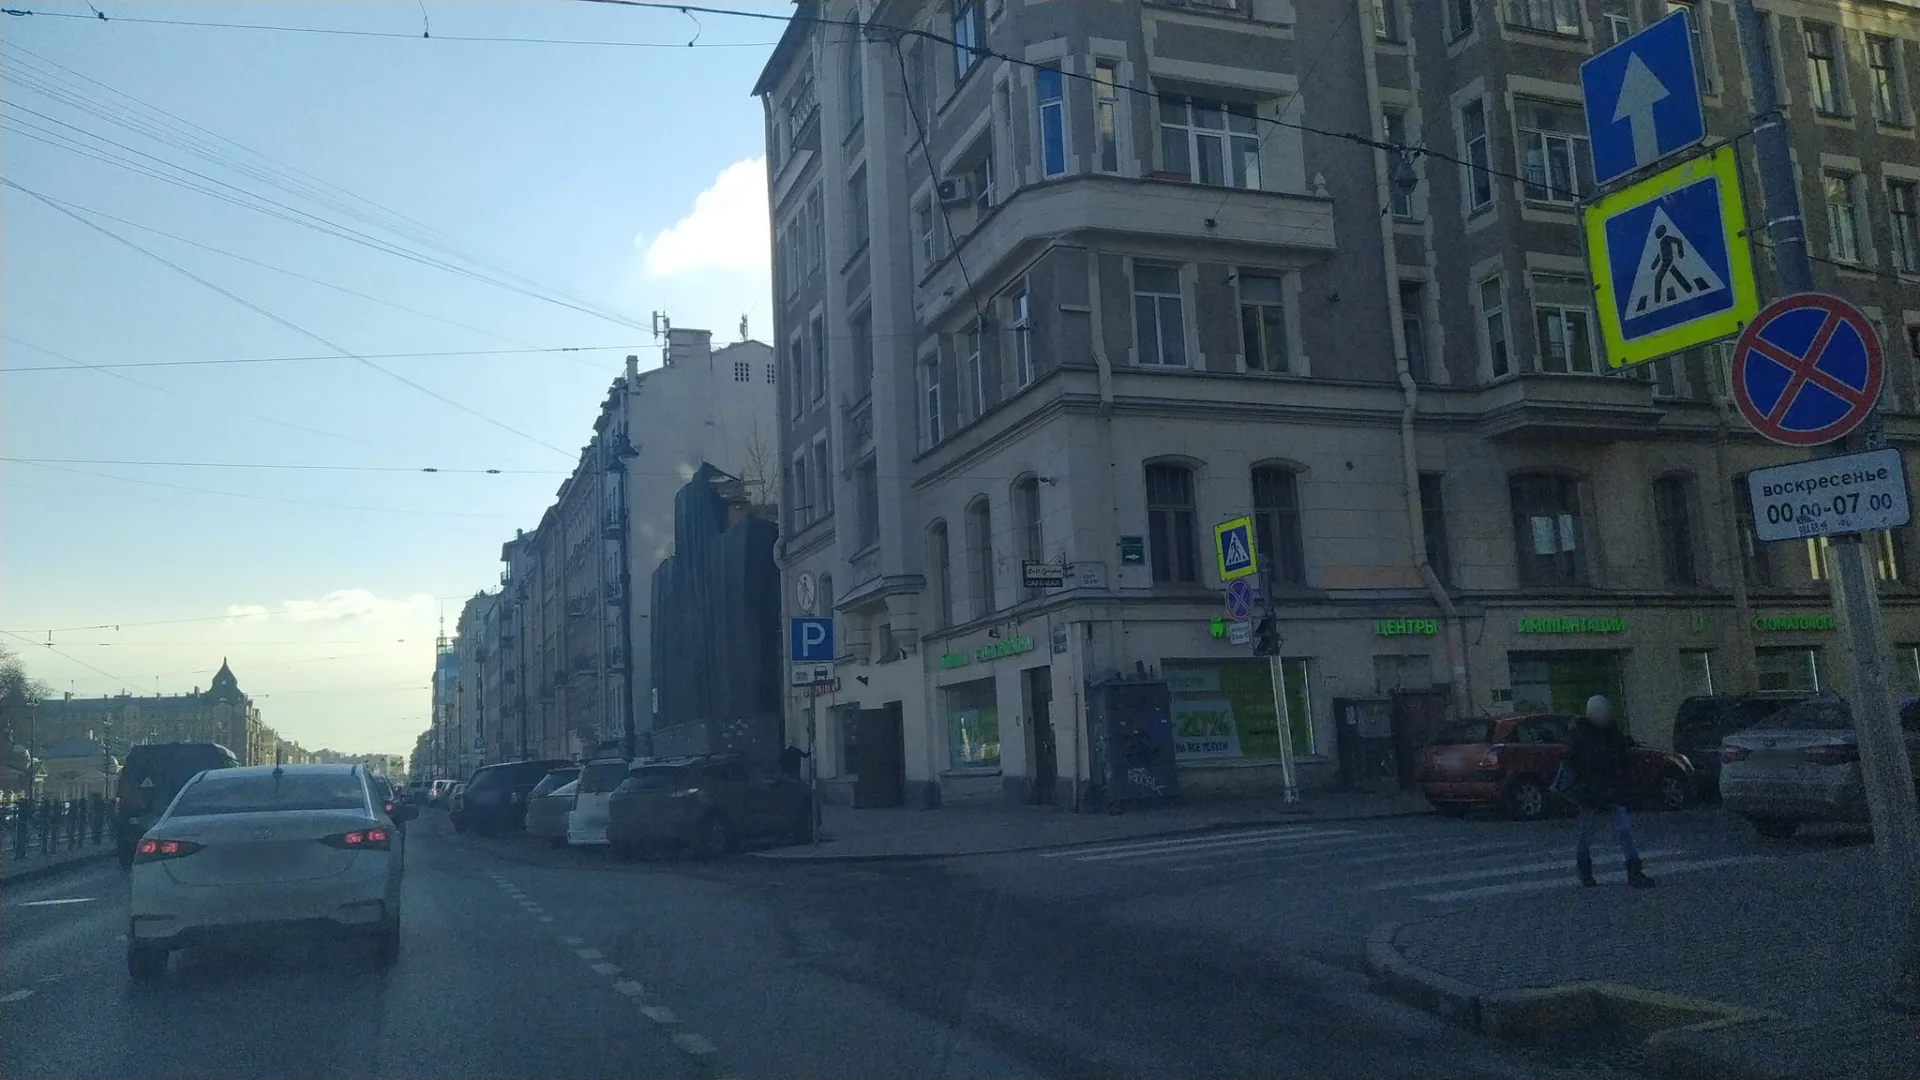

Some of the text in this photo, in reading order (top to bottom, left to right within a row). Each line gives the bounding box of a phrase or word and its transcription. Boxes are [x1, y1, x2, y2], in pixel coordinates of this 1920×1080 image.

[1763, 467, 1888, 495] воскресенье
[1374, 618, 1438, 636] ЦЕНТРЫ
[1518, 616, 1626, 634] ИМПЛАНТАЦИИ
[802, 622, 826, 657] P
[1175, 743, 1186, 753] НА
[1187, 742, 1201, 753] ВСЕ
